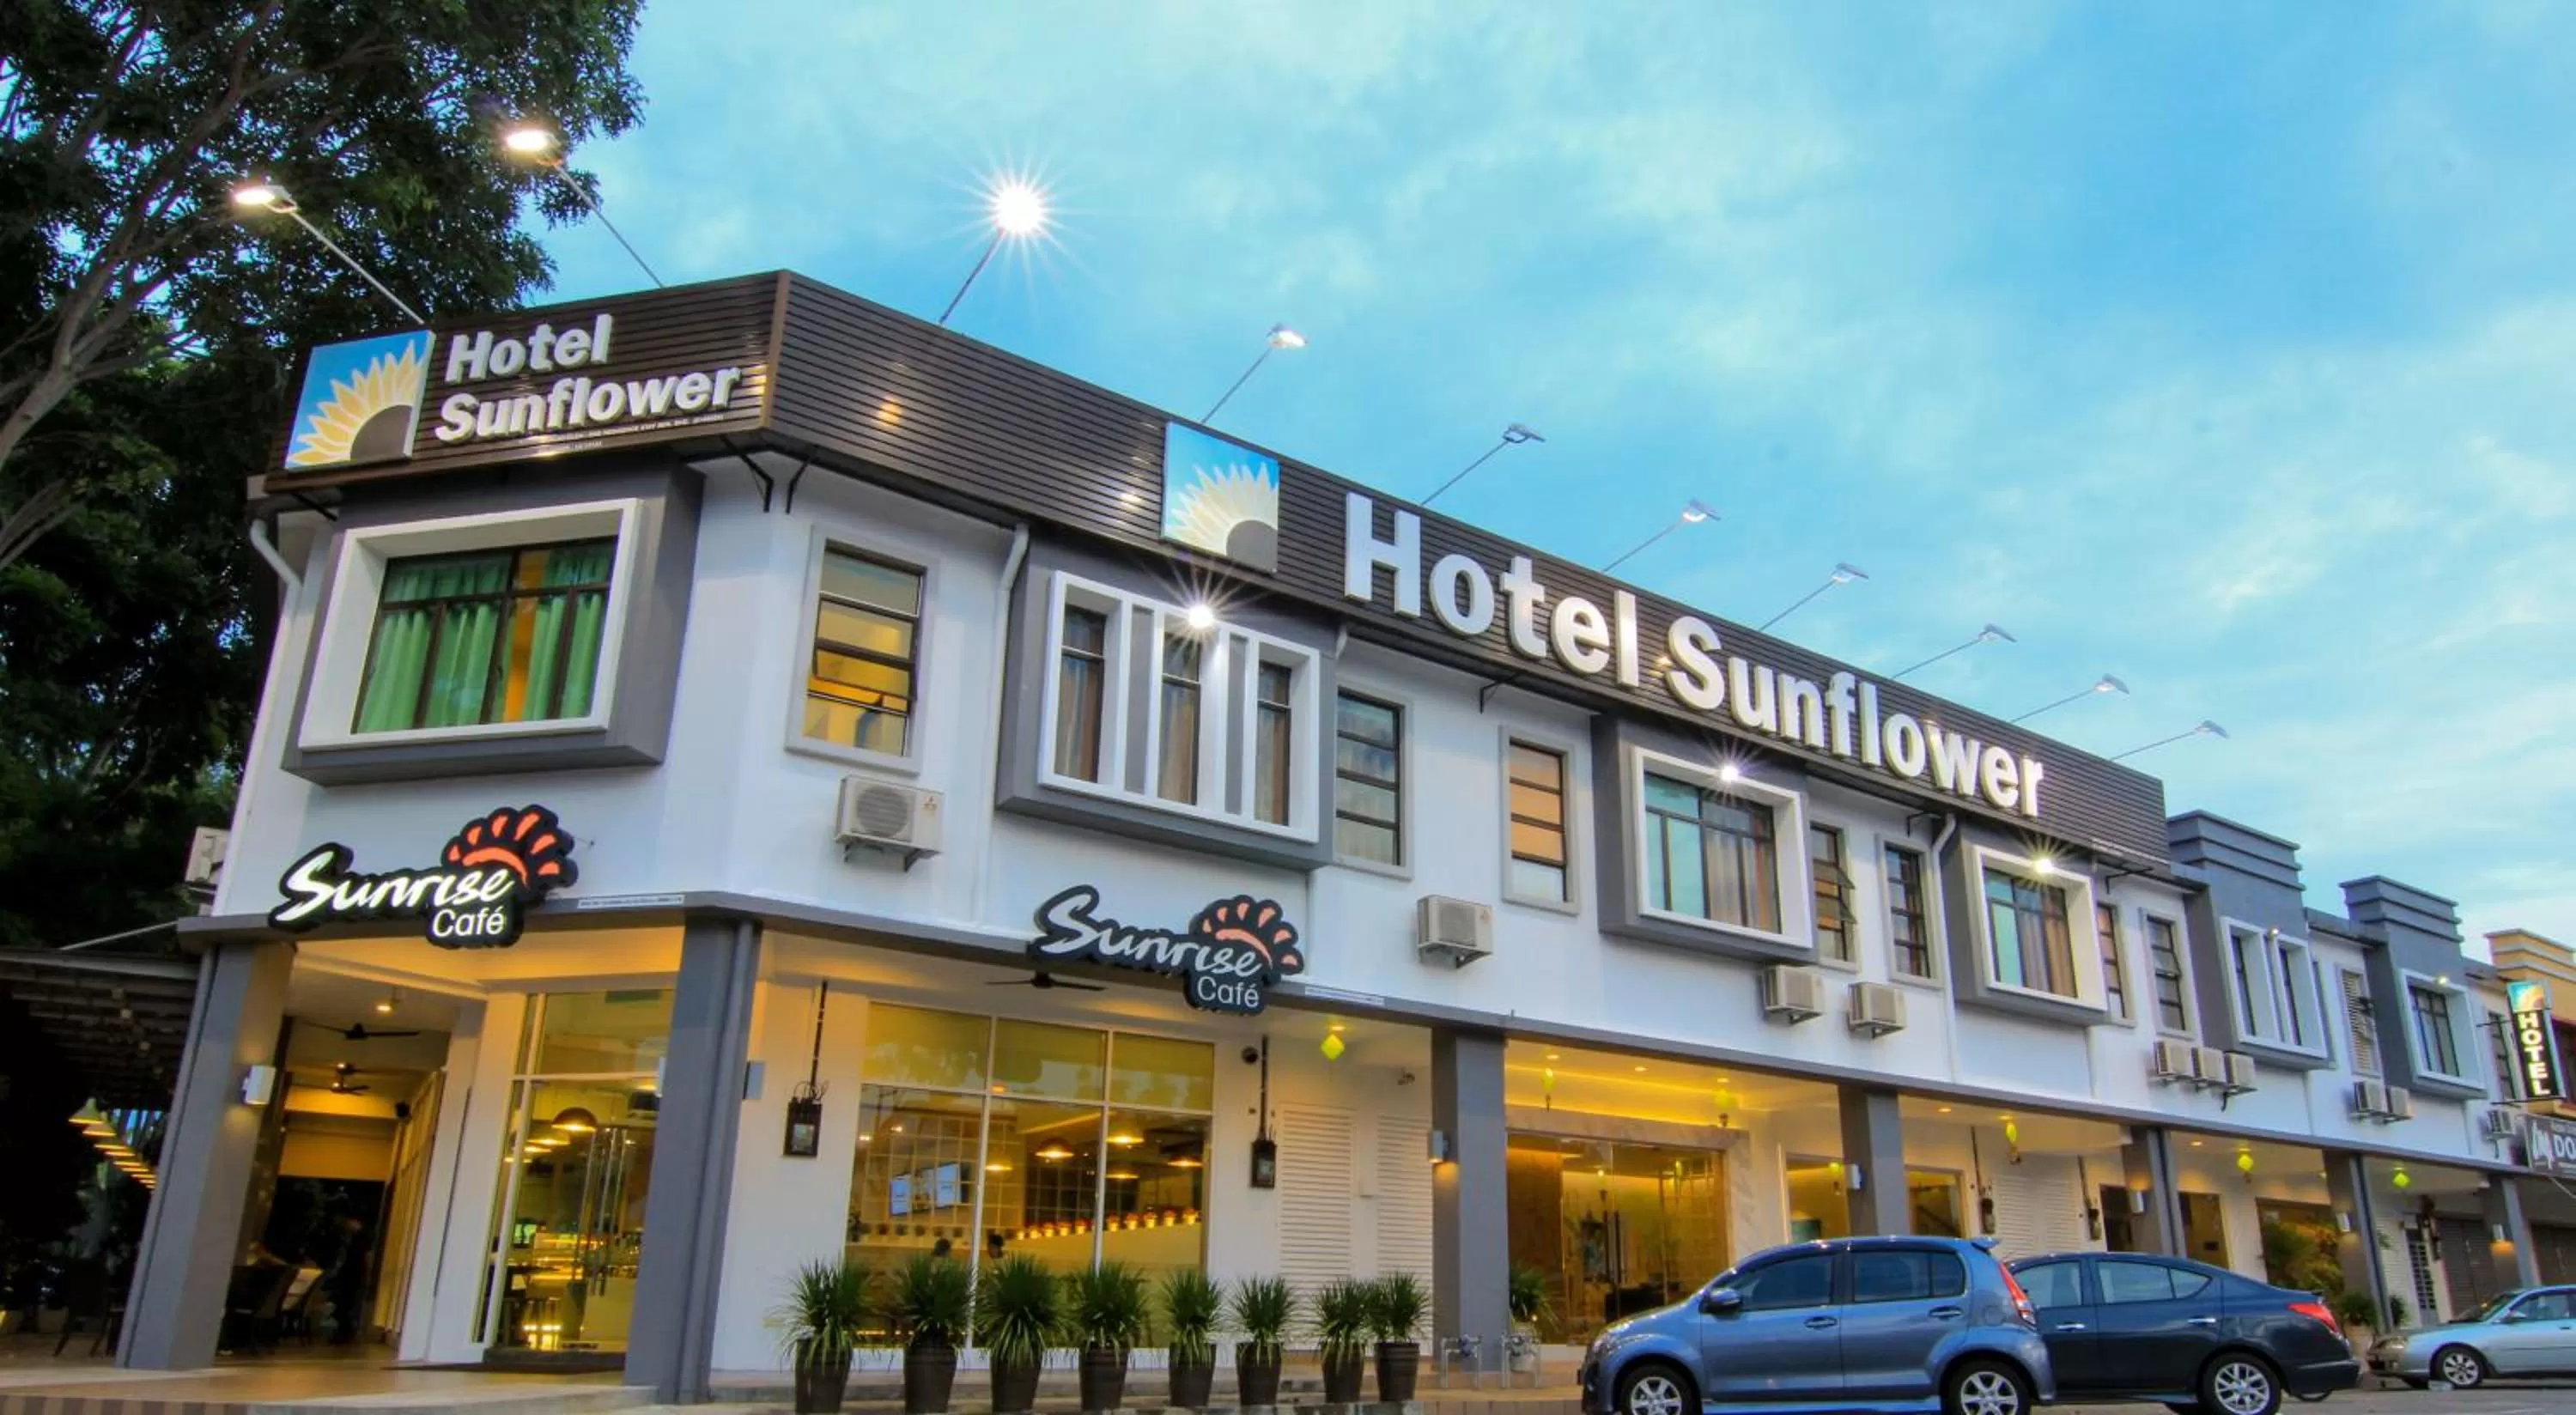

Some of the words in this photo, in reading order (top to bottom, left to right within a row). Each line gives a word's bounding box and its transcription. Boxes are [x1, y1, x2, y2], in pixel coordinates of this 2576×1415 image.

[445, 313, 614, 384] Hotel
[434, 367, 741, 442] Sunflower
[1344, 491, 1640, 687] Hotel
[1665, 616, 2044, 817] Sunflower
[276, 850, 514, 921] Sunrise
[432, 906, 508, 938] Café
[1040, 895, 1262, 978] Sunrise
[1196, 976, 1260, 1009] Café
[2518, 1012, 2550, 1096] HOTEL
